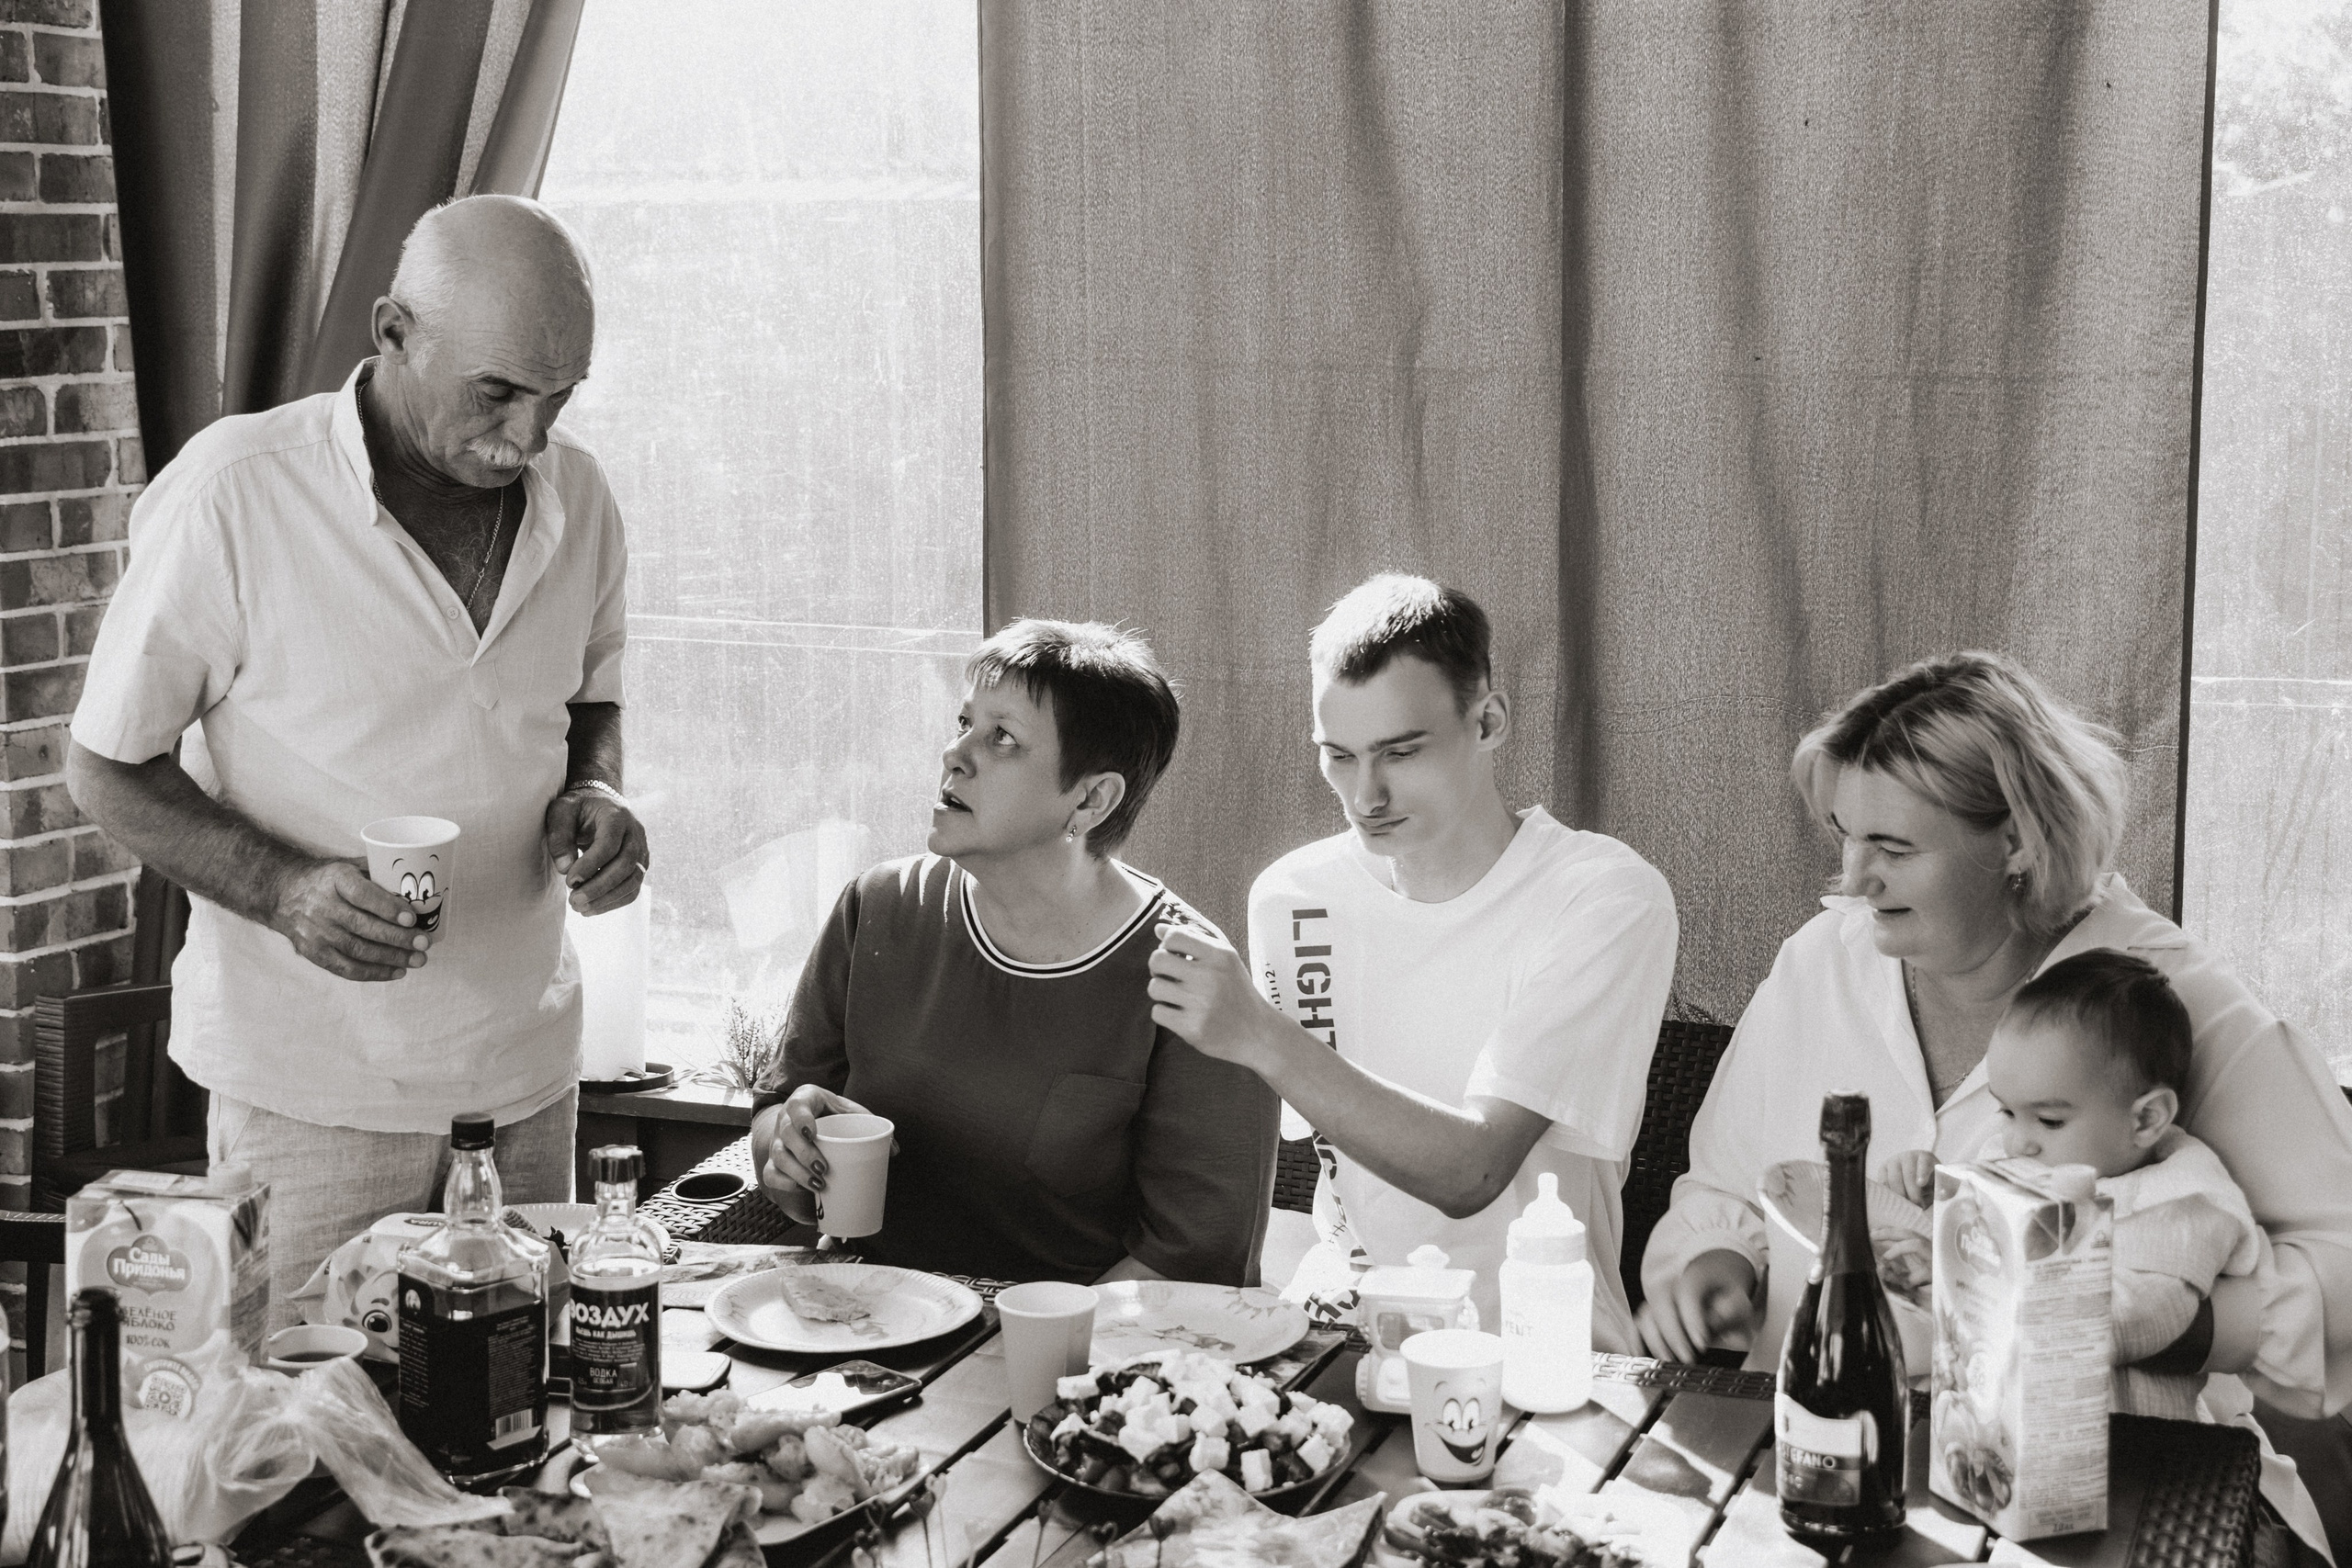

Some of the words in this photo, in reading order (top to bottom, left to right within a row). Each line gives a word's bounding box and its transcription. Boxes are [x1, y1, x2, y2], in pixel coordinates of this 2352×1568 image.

[130, 1247, 170, 1266] Сады
[113, 1258, 186, 1280] Придонья
[589, 1367, 617, 1378] ВОДКА
